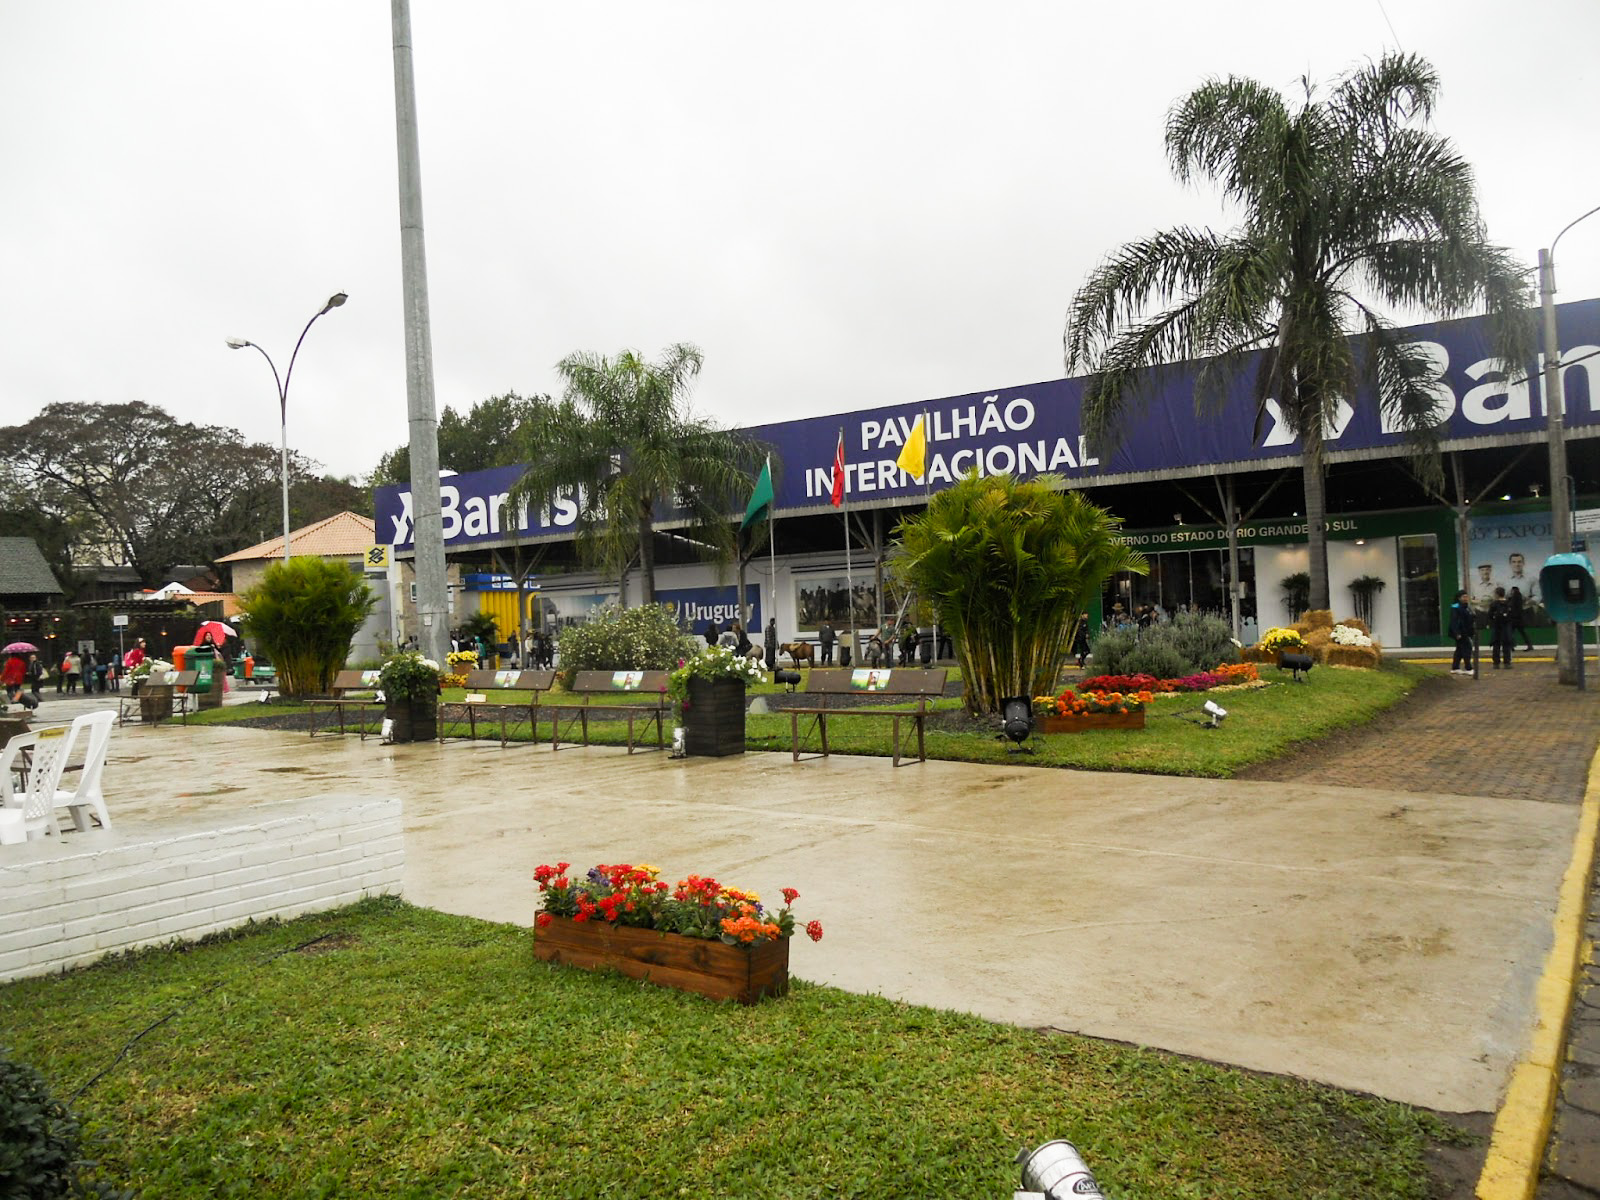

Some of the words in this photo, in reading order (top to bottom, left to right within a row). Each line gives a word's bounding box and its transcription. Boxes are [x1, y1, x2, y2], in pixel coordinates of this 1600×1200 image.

[861, 394, 1035, 451] PAVILHÃO
[1107, 534, 1150, 547] OVERNO
[1151, 533, 1168, 544] DO
[1170, 531, 1215, 544] ESTADO
[1236, 527, 1256, 538] RIO
[1258, 524, 1309, 536] GRANDE
[1332, 520, 1358, 531] SUL
[684, 602, 755, 625] Uruguay
